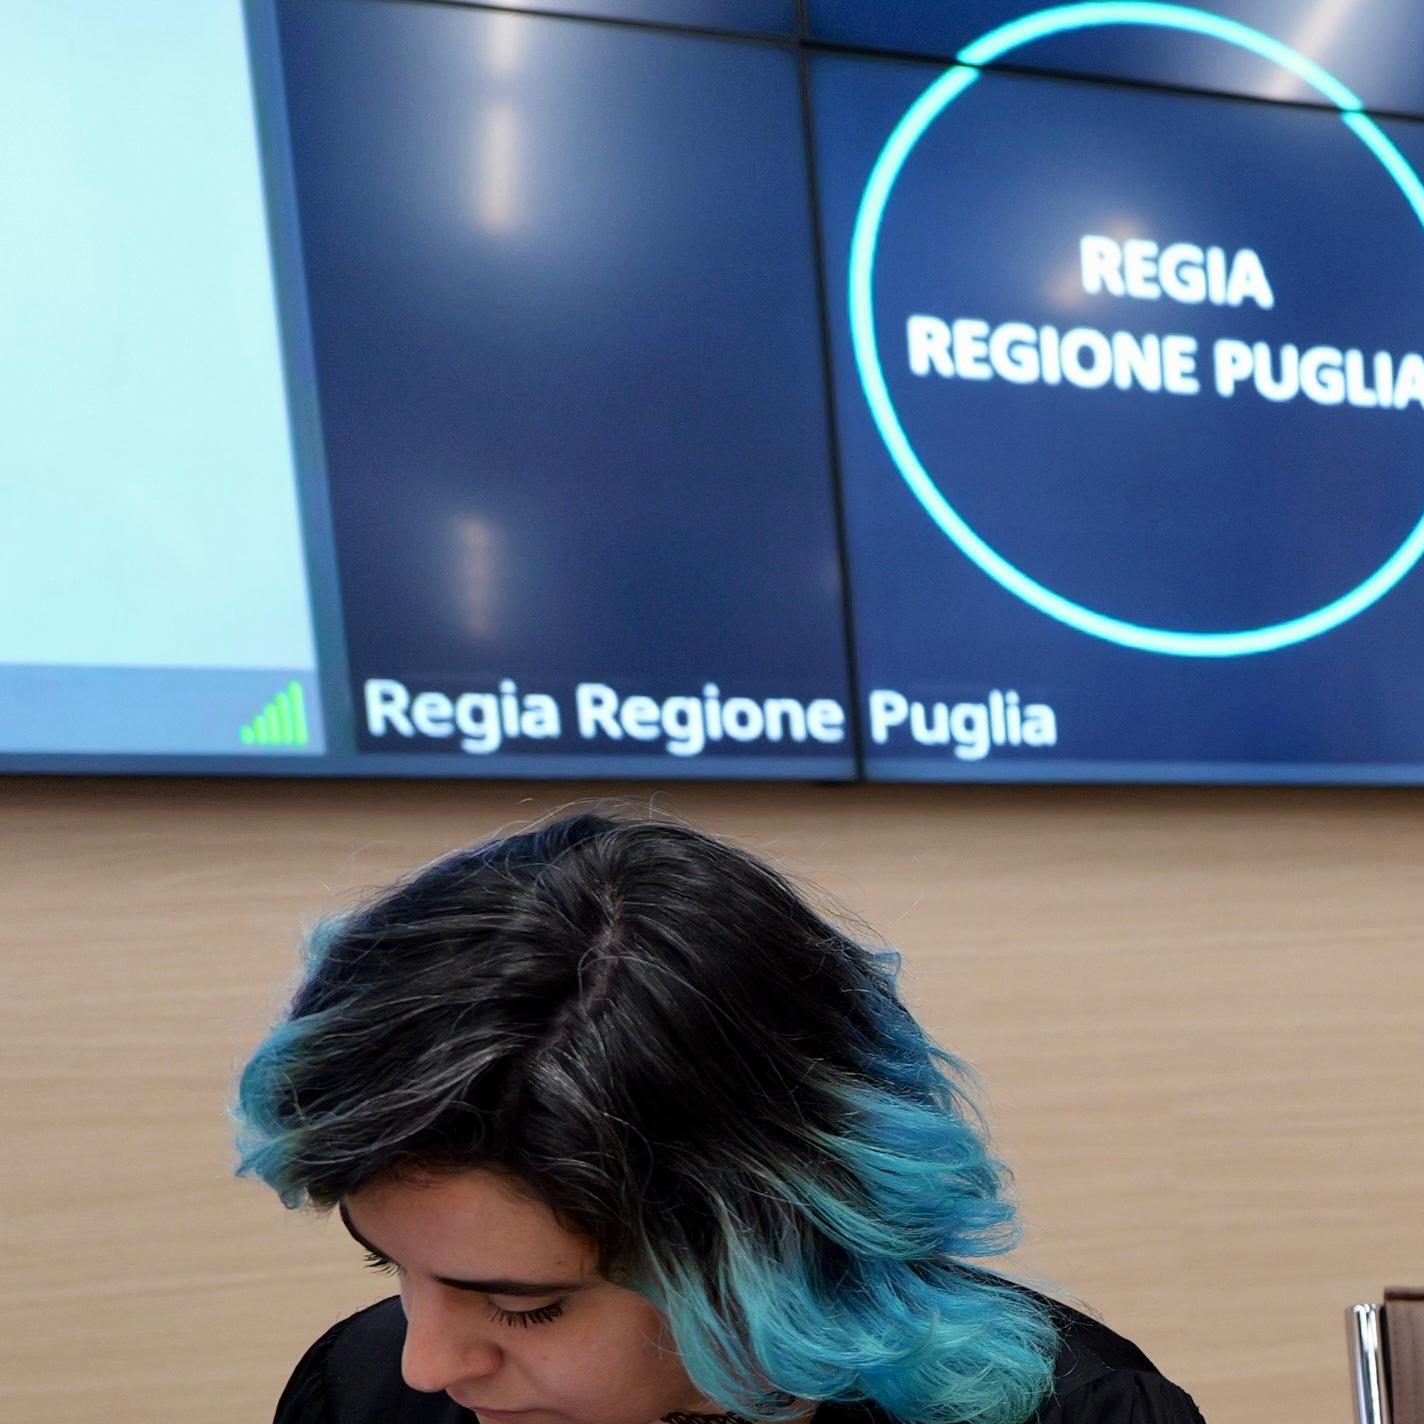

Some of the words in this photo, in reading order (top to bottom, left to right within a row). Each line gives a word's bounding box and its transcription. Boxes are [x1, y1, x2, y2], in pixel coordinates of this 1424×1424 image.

[1079, 234, 1275, 309] REGIA
[906, 314, 1201, 395] REGIONE
[365, 679, 561, 754] Regia
[576, 682, 846, 756] Regione
[869, 689, 1058, 760] Puglia
